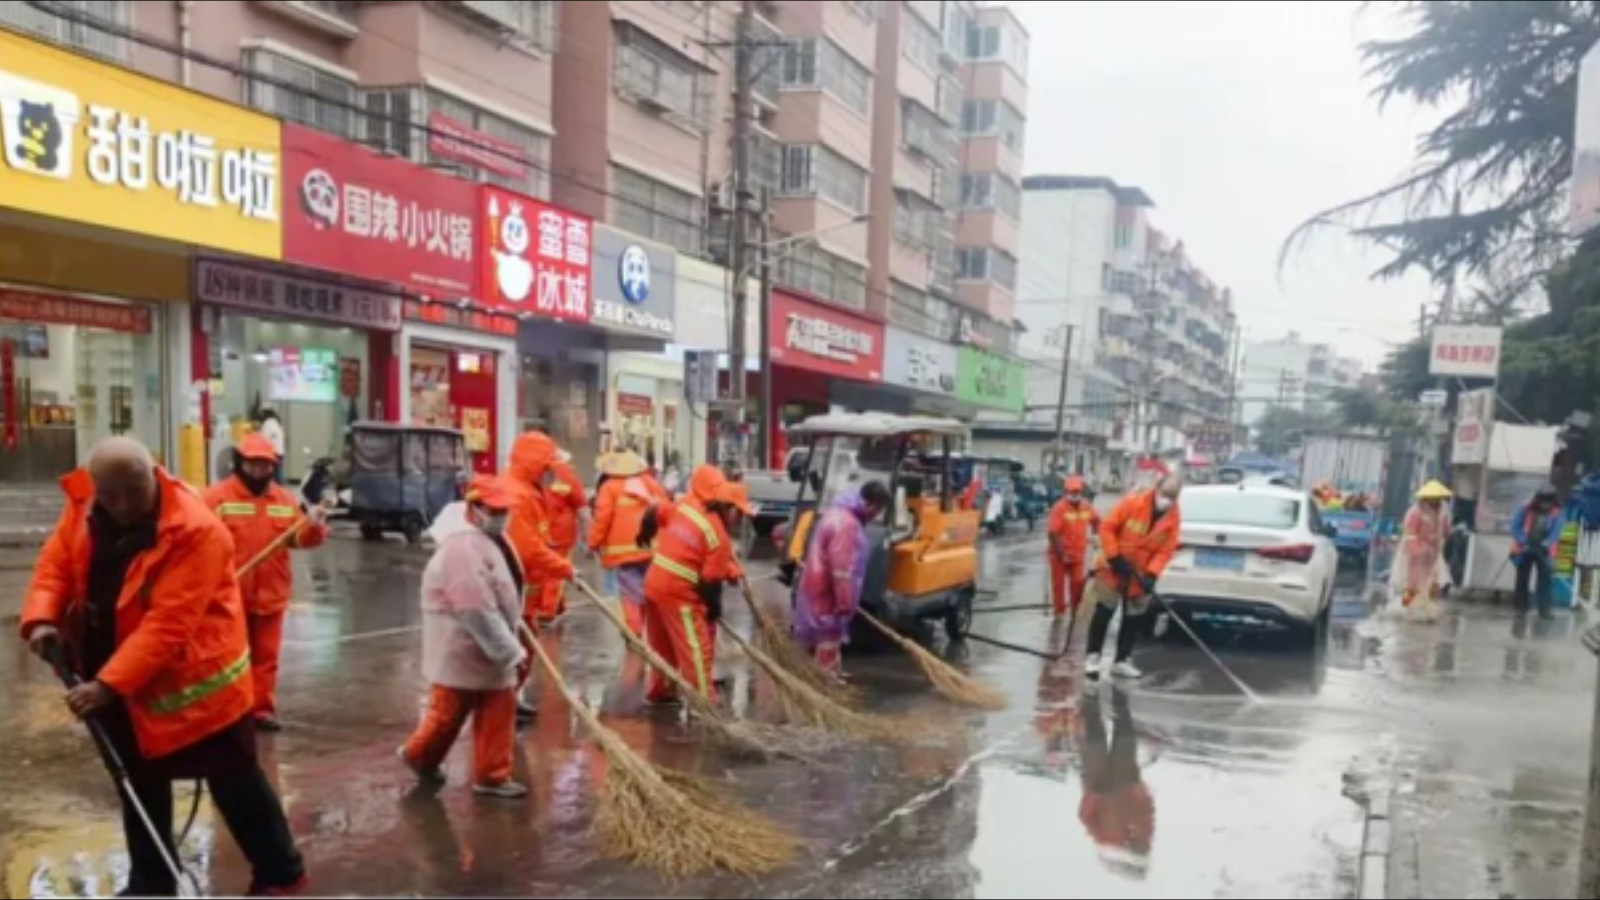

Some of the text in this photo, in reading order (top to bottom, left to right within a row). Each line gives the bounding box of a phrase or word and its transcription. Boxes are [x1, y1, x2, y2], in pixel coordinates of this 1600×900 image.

[86, 103, 276, 220] 甜啦啦
[343, 183, 473, 262] 围辣小火锅
[538, 209, 589, 266] 蜜雪
[537, 262, 588, 318] 冰城
